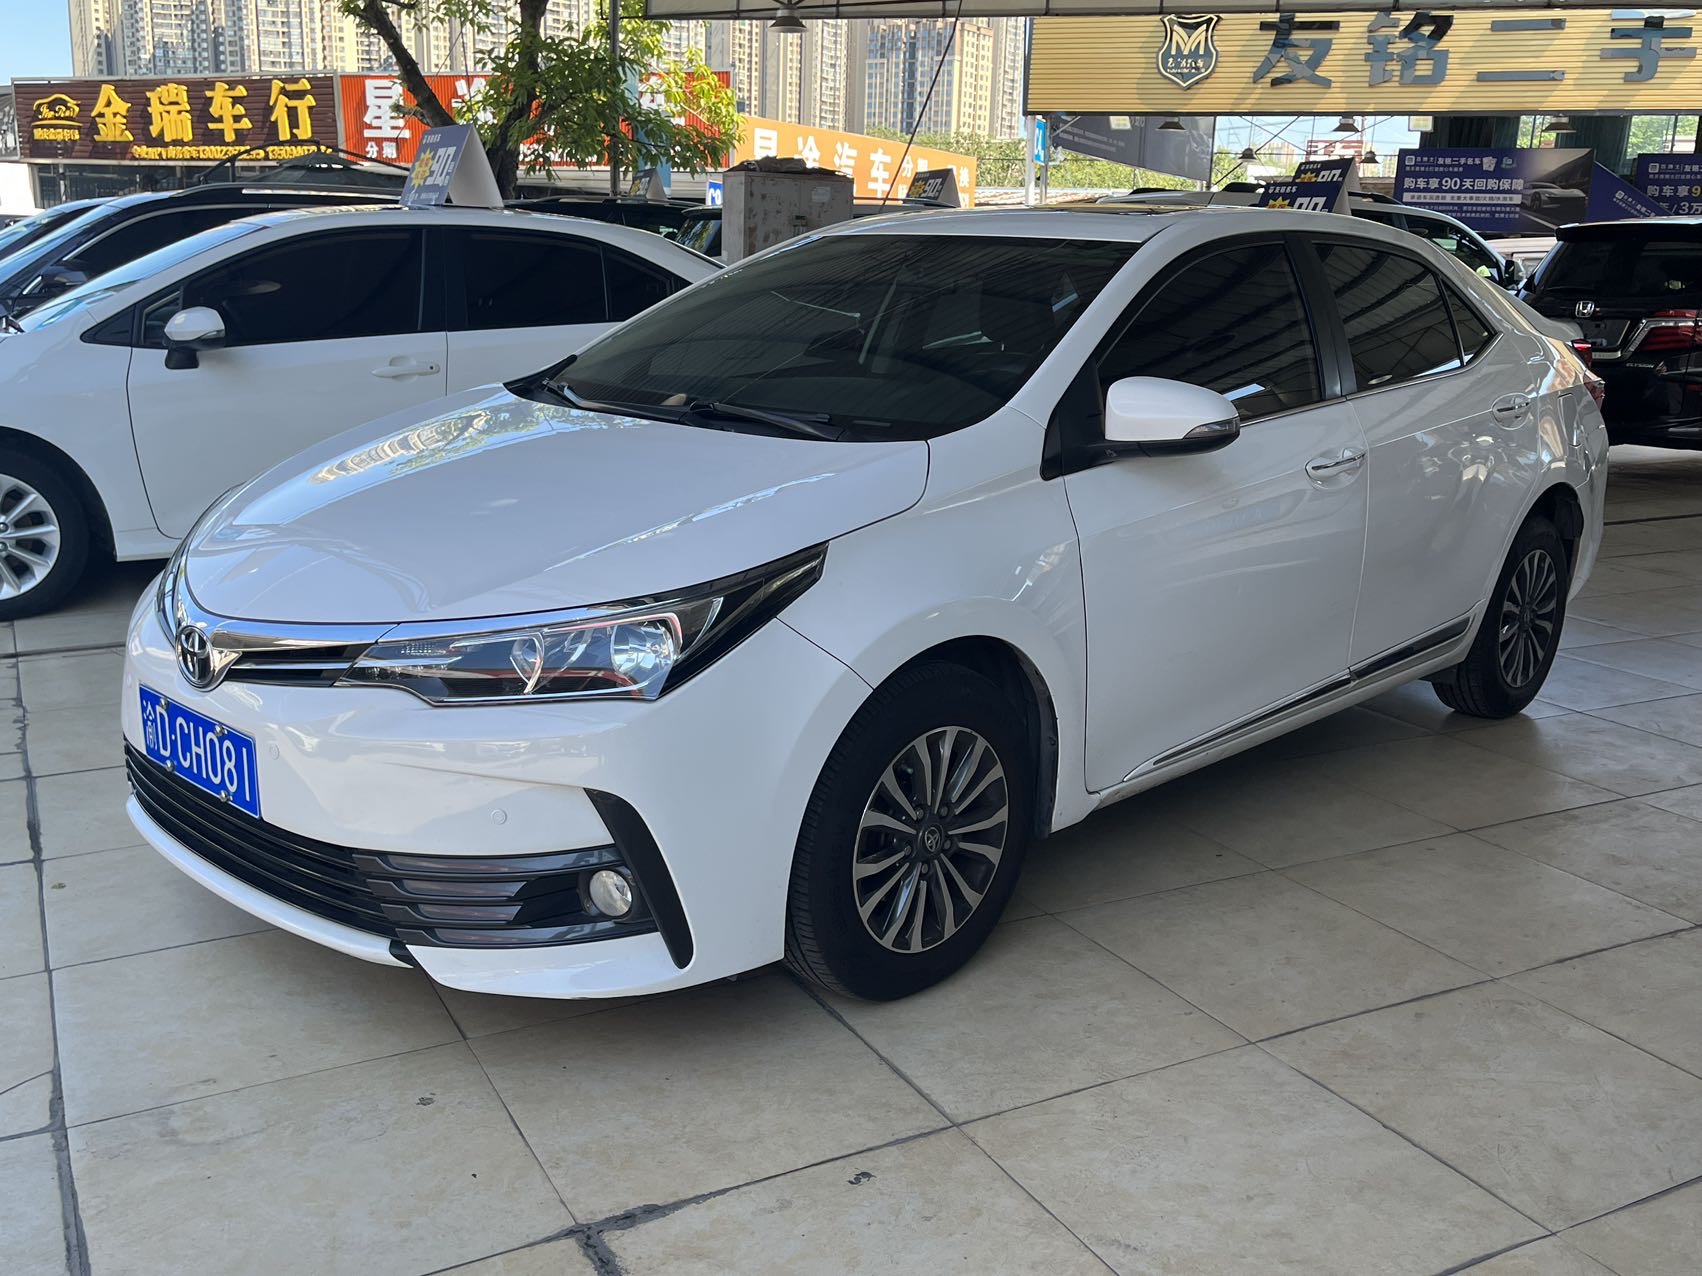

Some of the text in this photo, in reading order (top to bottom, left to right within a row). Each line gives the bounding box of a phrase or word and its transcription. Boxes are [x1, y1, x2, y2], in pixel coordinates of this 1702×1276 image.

[1253, 10, 1698, 89] 友铭二手
[91, 78, 317, 142] 金瑞车行
